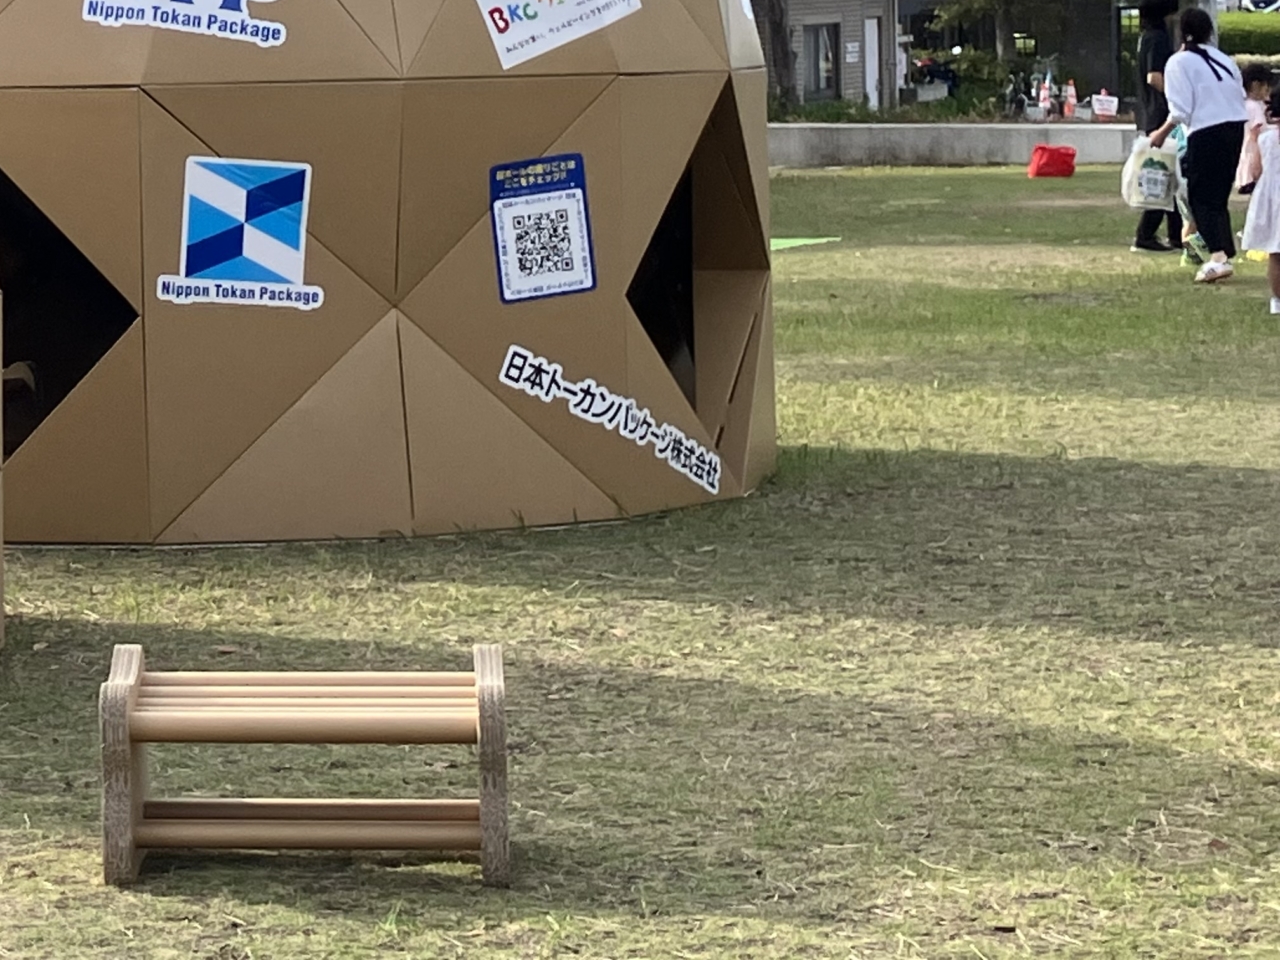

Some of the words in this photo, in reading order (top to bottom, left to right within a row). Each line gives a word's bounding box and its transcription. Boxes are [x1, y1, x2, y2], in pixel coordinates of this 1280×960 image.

[87, 0, 145, 23] Nippon
[151, 6, 202, 29] Tokan
[207, 13, 281, 43] Package
[161, 281, 210, 298] Nippon
[214, 284, 256, 299] Tokan
[259, 287, 320, 305] Package
[504, 351, 718, 490] 日本トーカンパッケージ株式会社
